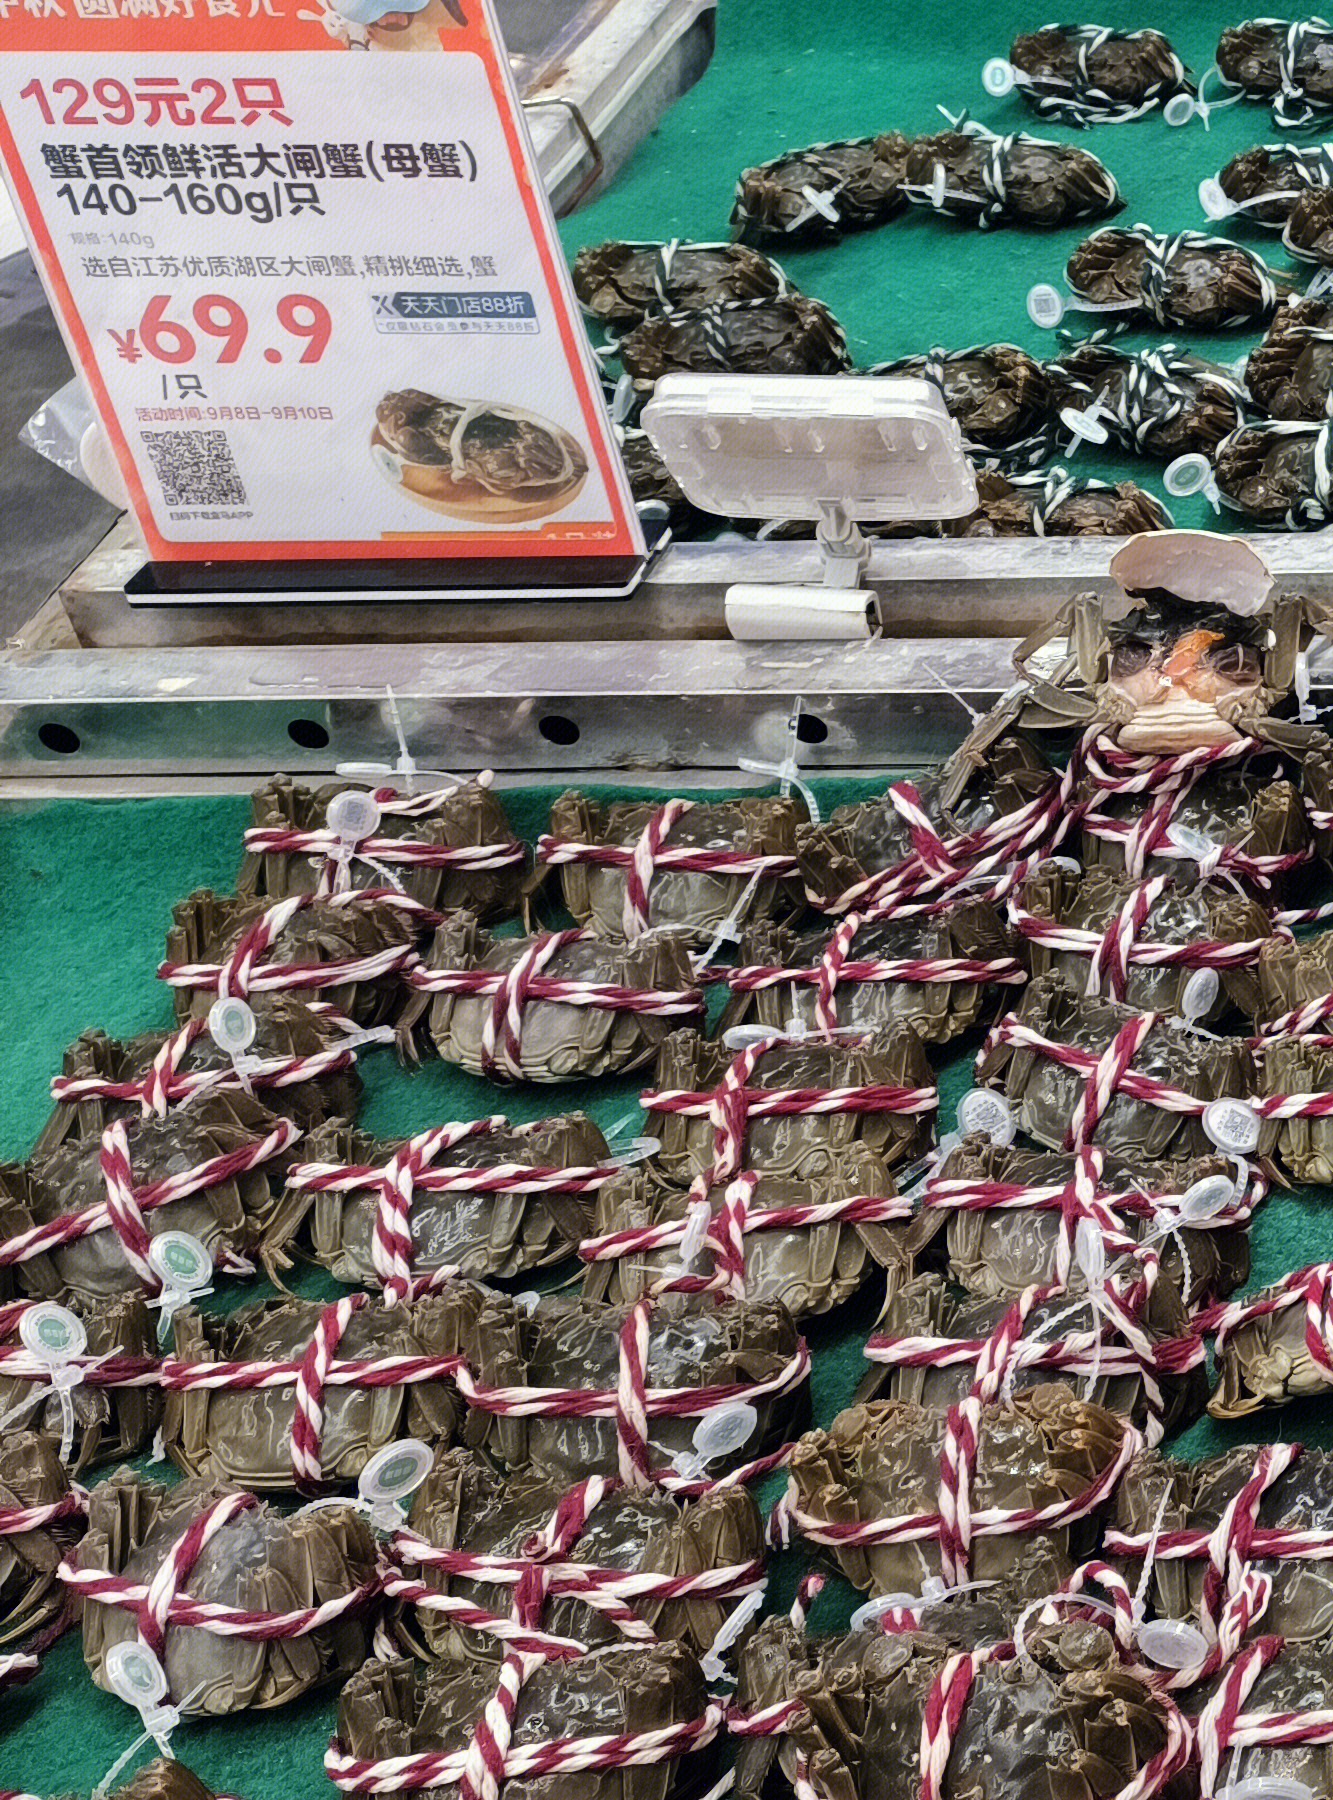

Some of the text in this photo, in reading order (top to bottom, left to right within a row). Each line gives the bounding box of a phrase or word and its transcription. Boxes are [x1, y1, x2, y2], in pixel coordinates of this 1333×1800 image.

[20, 76, 294, 128] 129元2只
[40, 139, 479, 182] 蟹首领鲜活大闸蟹(母蟹)
[400, 295, 526, 315] 天天门店88折
